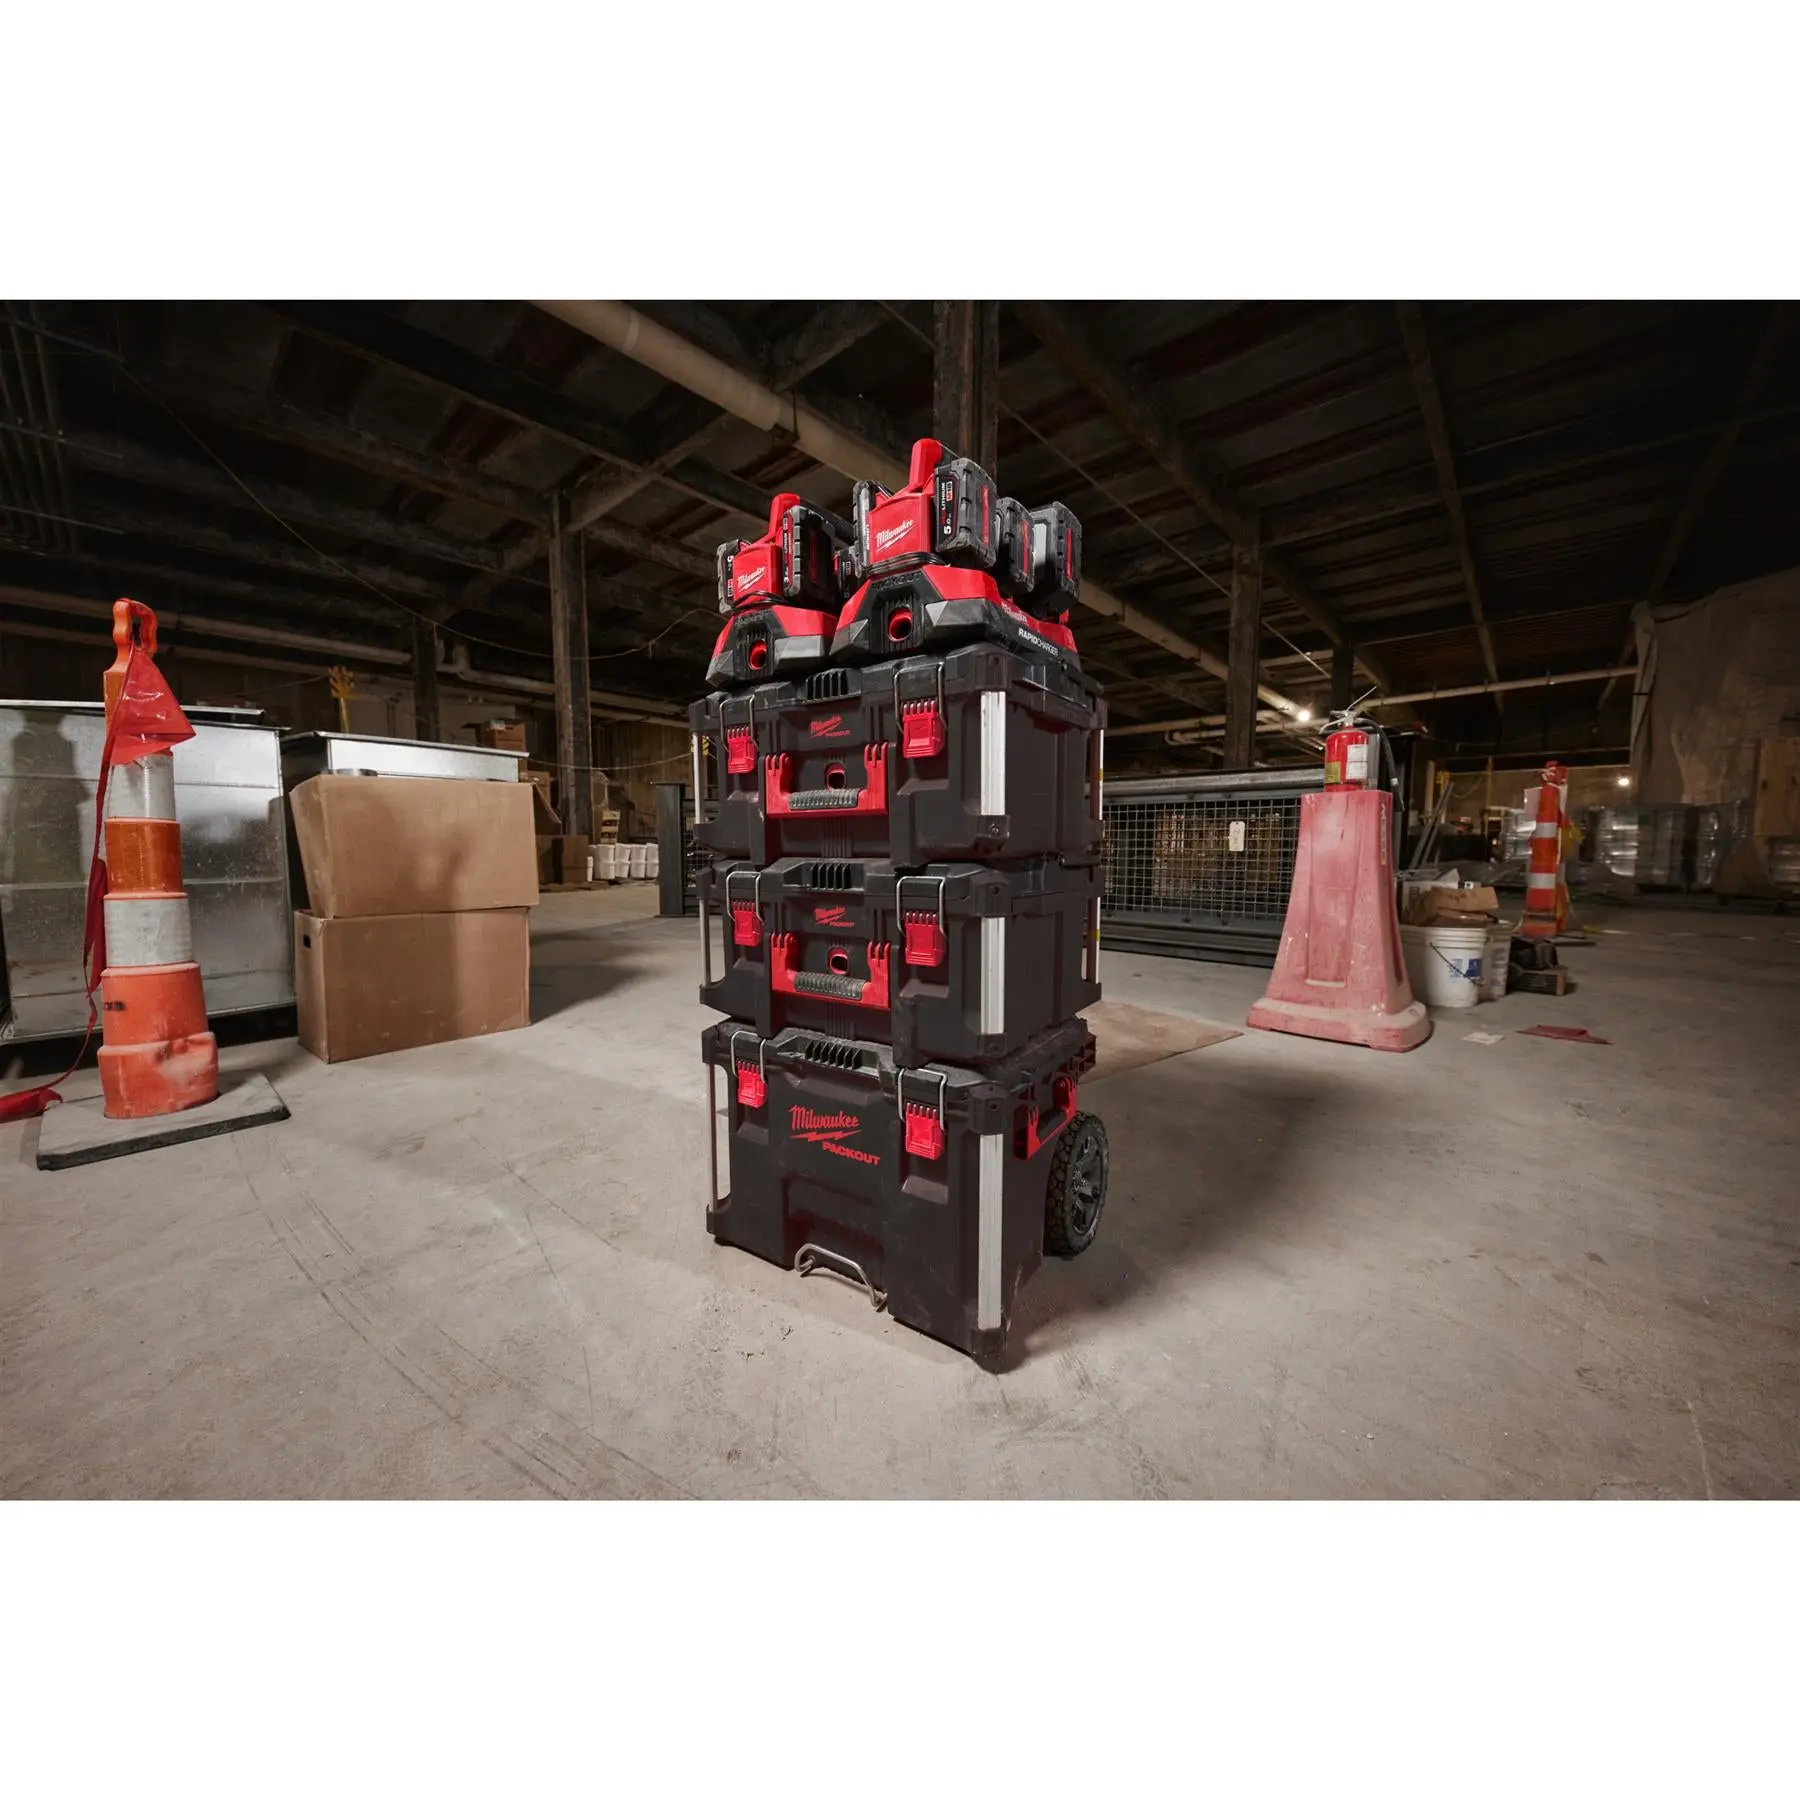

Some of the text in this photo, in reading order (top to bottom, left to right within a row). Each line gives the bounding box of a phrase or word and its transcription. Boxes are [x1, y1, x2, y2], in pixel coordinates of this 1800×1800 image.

[876, 519, 913, 548] Milwaukee
[788, 1104, 860, 1130] Milwaukee
[822, 1141, 881, 1166] PACKOUT
